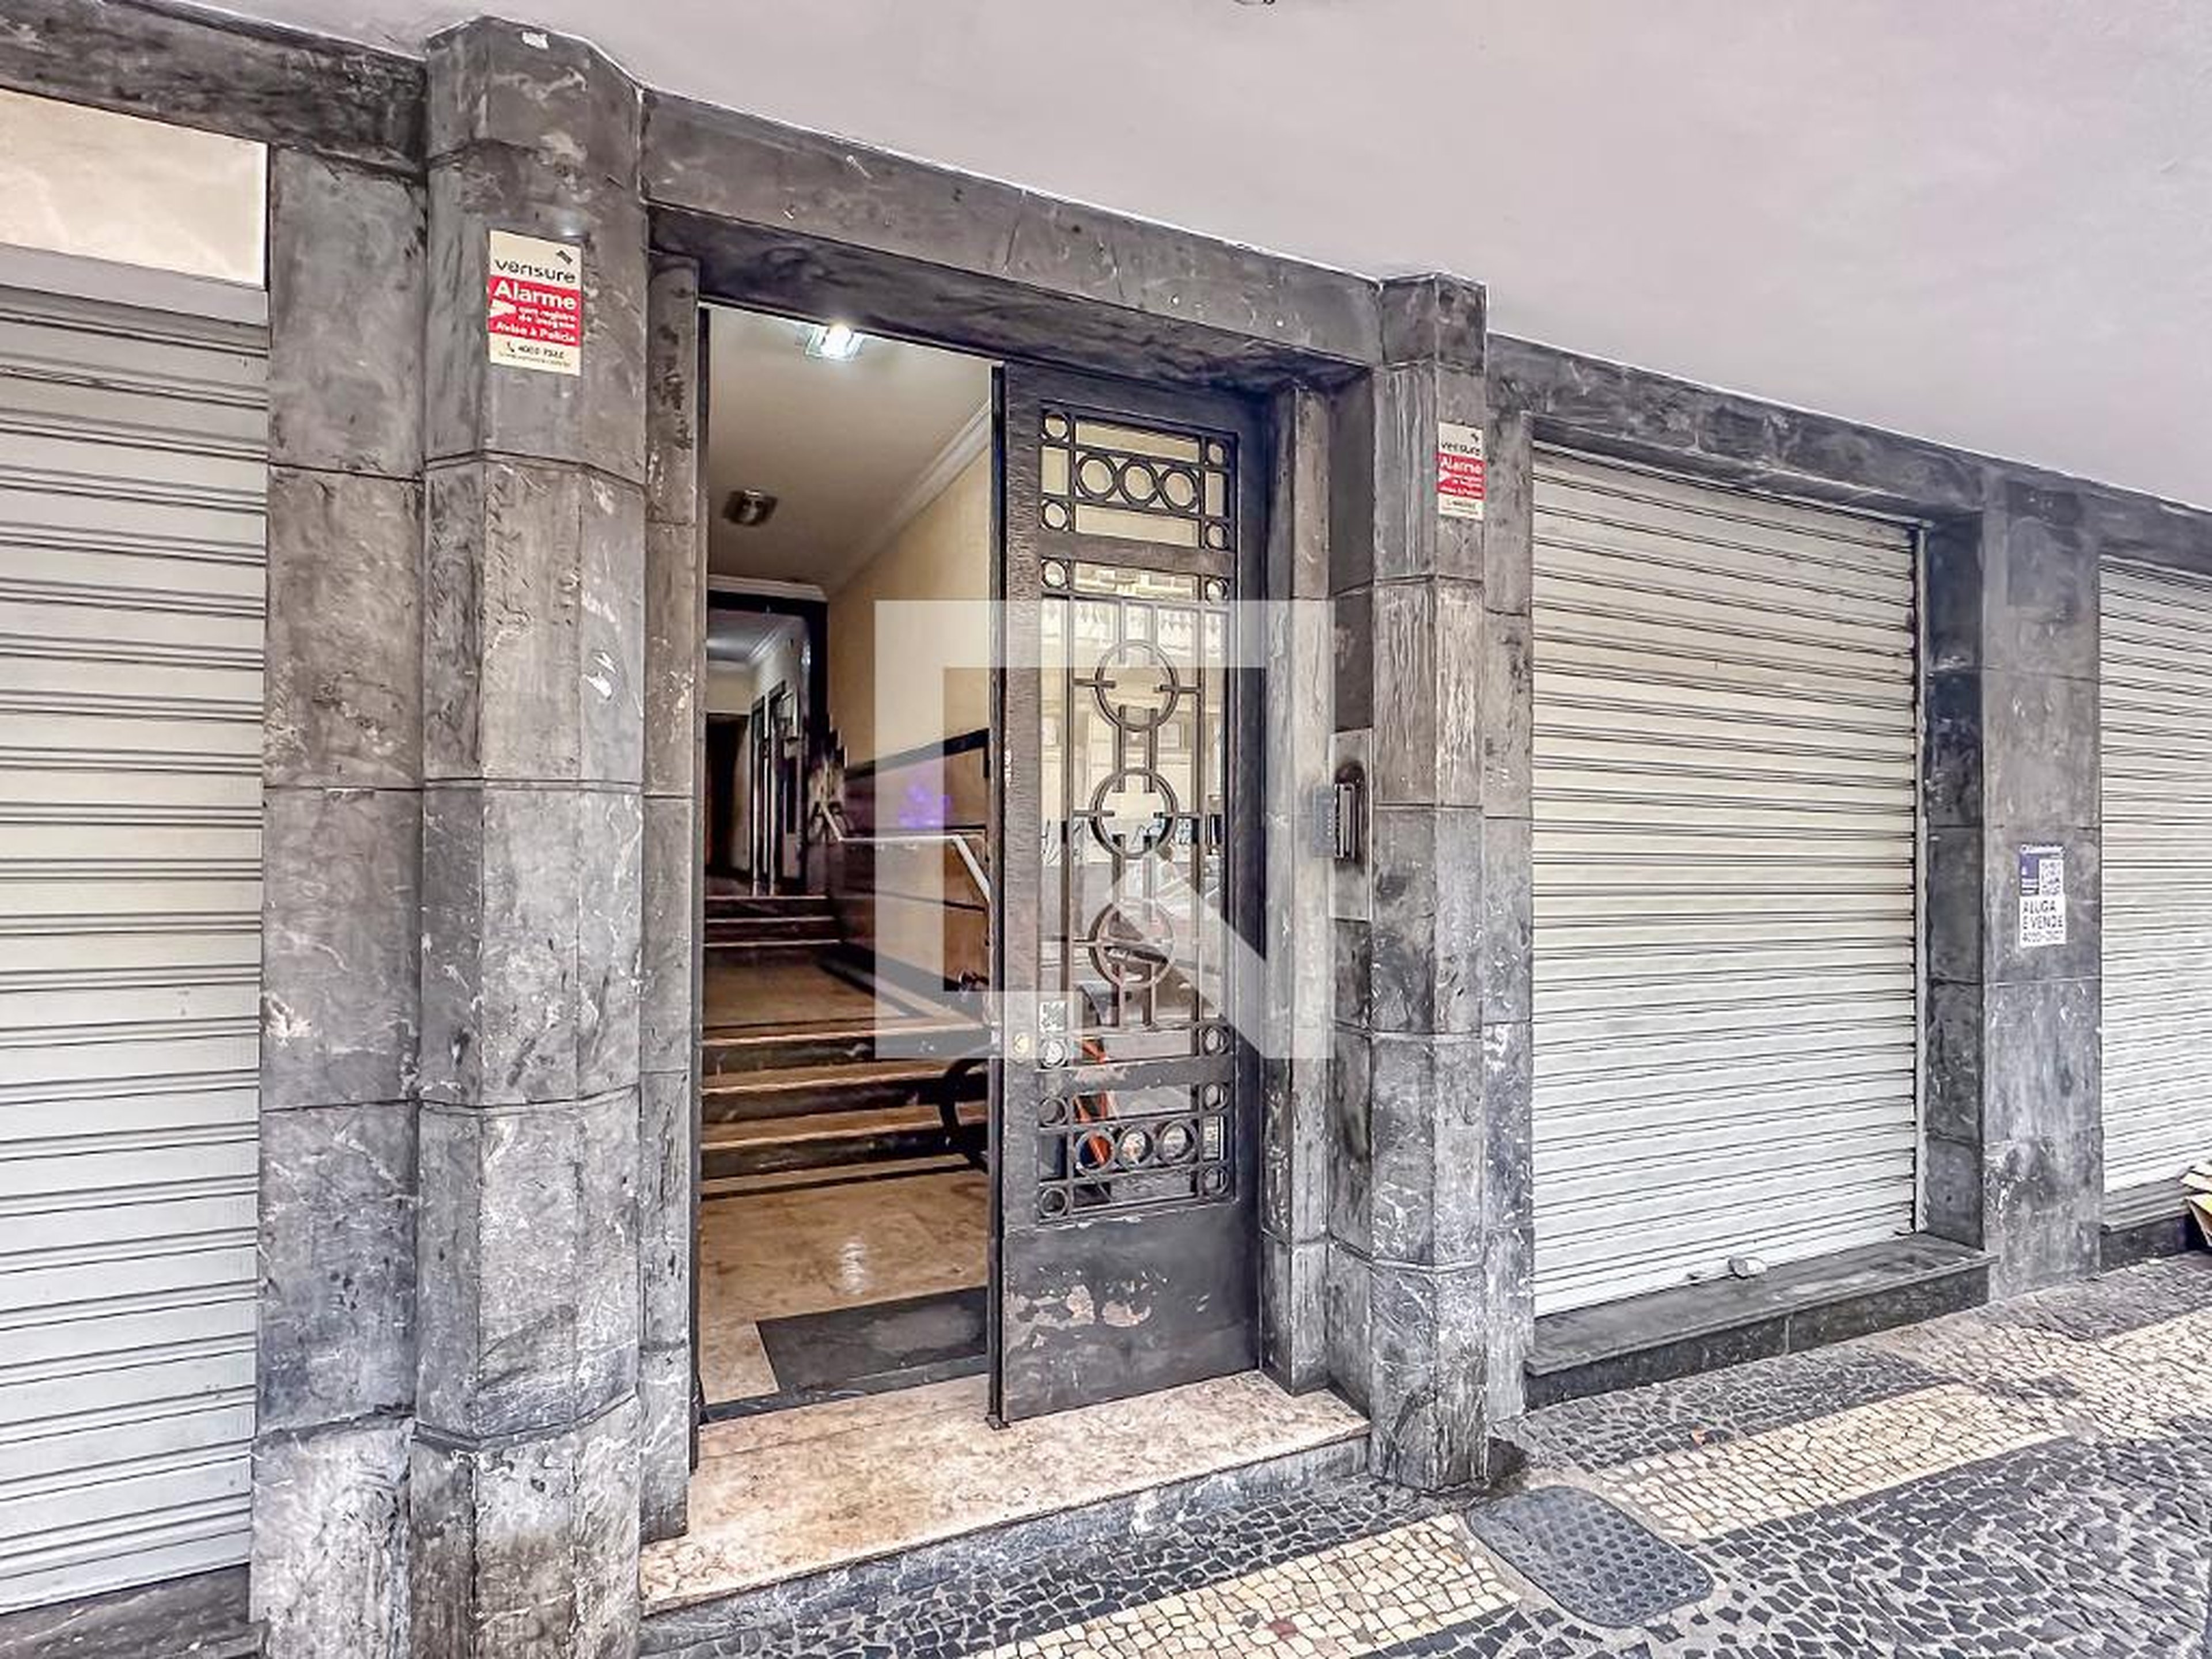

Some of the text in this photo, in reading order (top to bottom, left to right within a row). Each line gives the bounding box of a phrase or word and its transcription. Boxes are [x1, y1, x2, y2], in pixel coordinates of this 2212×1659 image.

[494, 280, 577, 310] Alarme
[2022, 900, 2057, 915] ALUGA
[2030, 914, 2063, 929] VENDE
